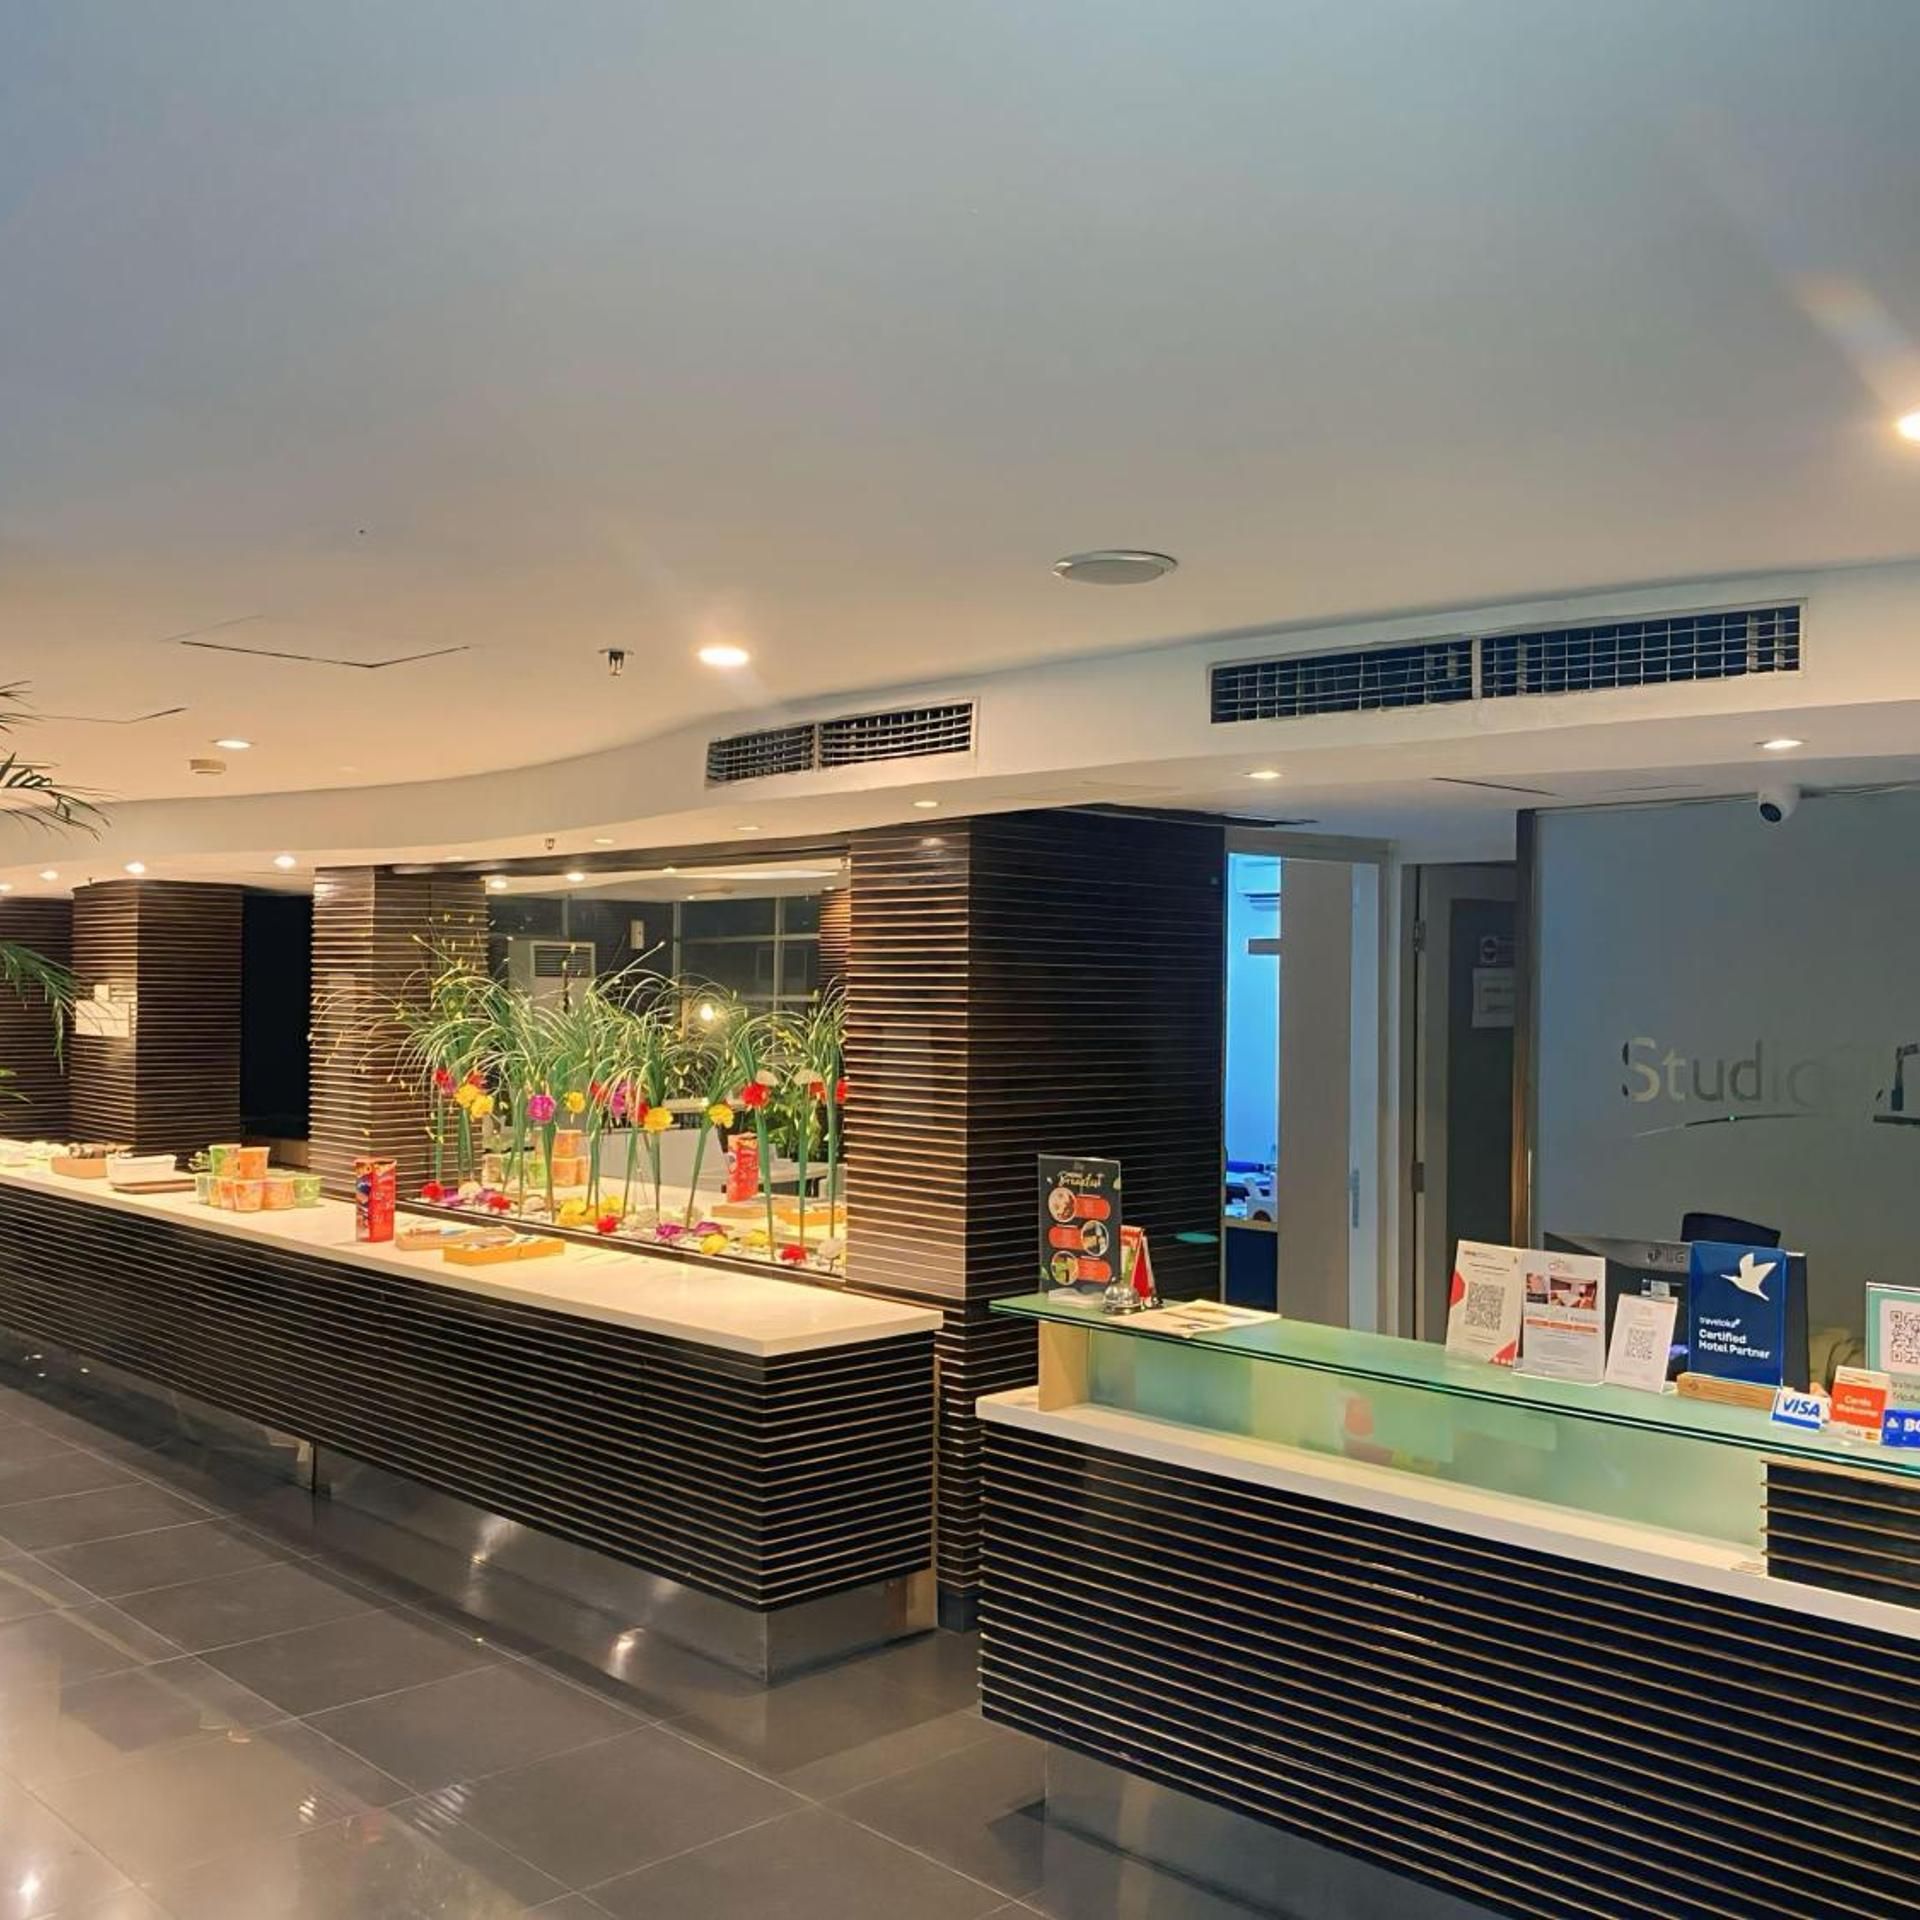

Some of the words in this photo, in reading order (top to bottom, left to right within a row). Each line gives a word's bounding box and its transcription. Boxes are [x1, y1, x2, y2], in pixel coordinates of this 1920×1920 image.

[1699, 1329, 1747, 1344] Certified
[1699, 1340, 1728, 1353] Hotel
[1729, 1344, 1770, 1359] Partner
[1783, 1399, 1821, 1417] VISA
